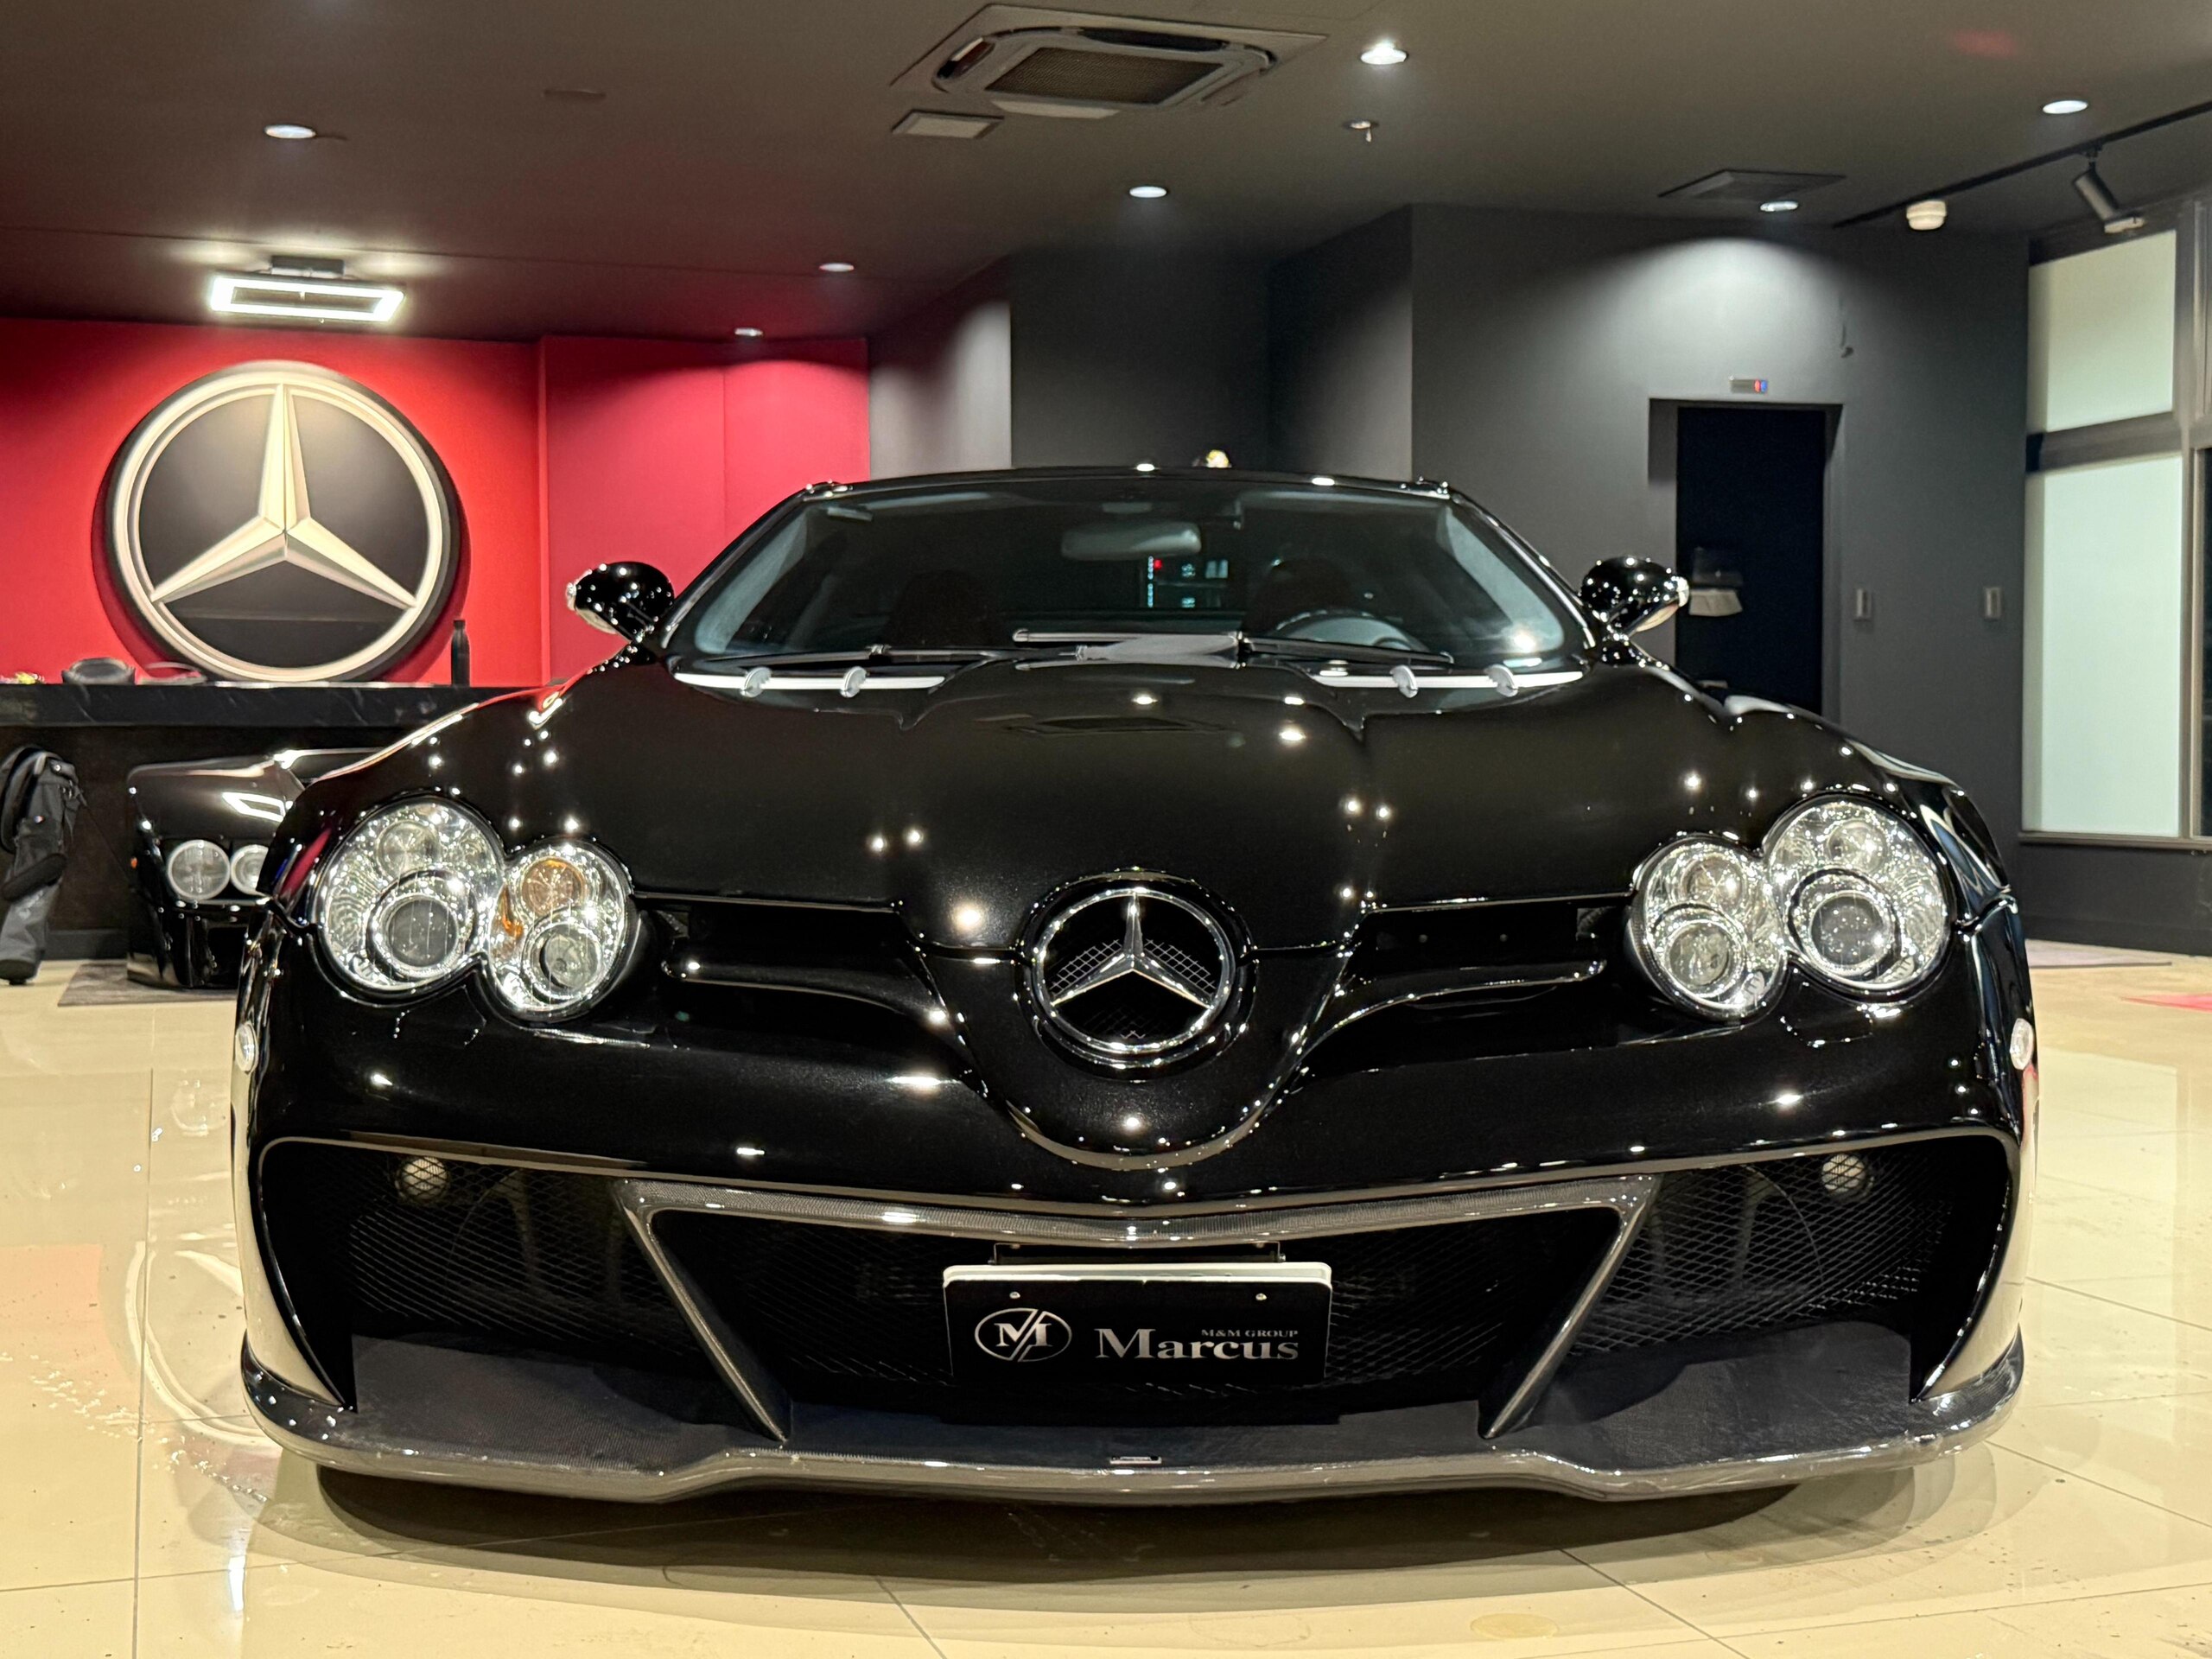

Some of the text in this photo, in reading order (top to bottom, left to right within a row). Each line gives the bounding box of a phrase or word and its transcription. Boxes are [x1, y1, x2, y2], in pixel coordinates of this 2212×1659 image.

[1201, 1329, 1299, 1338] M&M GROUP
[1094, 1328, 1299, 1360] Marcus
